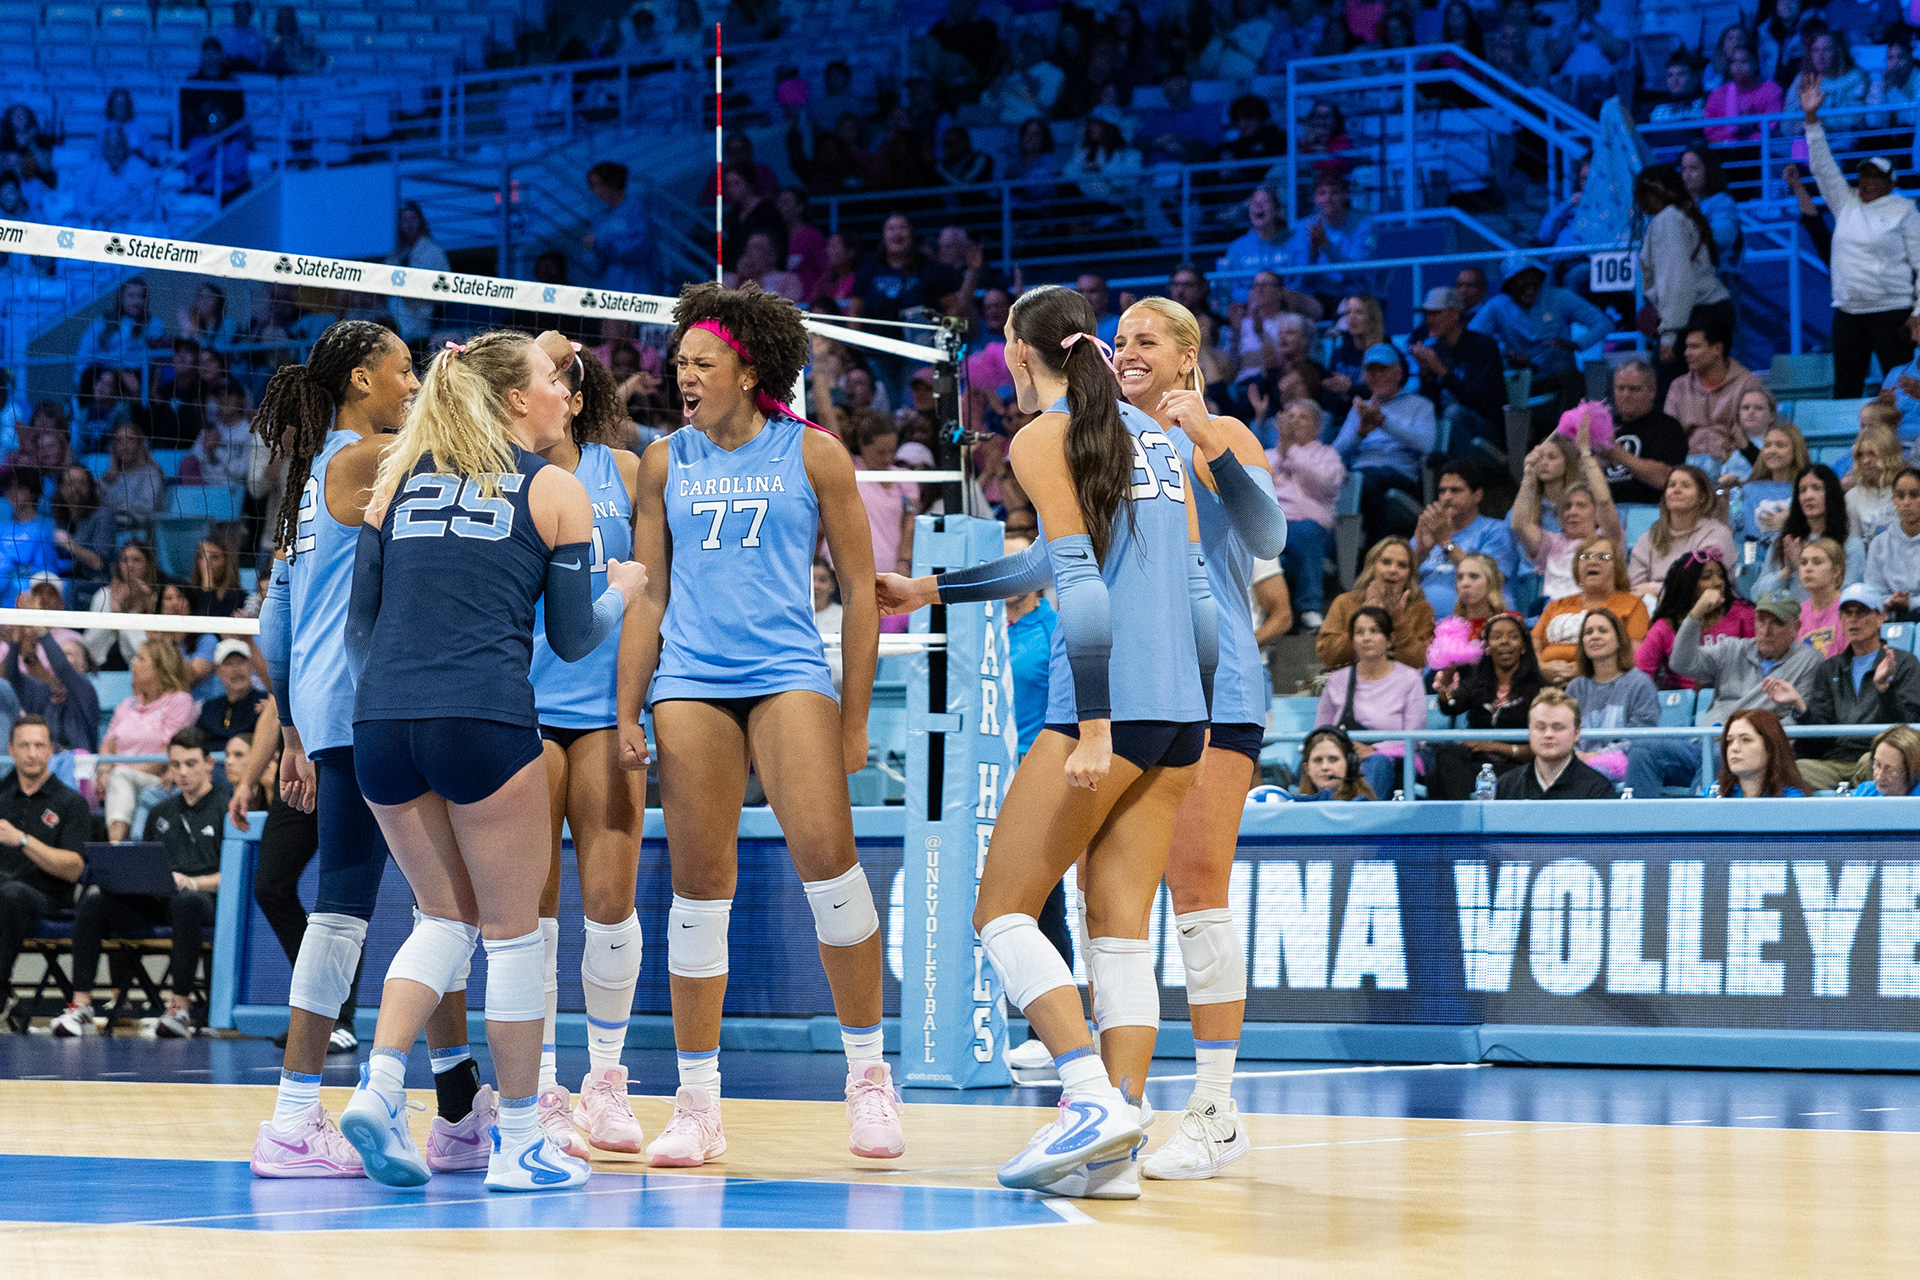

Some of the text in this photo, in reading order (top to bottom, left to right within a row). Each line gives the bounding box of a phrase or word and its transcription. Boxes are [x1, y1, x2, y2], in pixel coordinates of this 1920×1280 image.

[1597, 258, 1632, 282] 106
[392, 472, 526, 541] 25
[680, 474, 785, 497] CAROLINA
[692, 498, 769, 550] 77
[972, 762, 1000, 1063] HELS
[923, 835, 942, 1063] @UNCVOLLEYBALL
